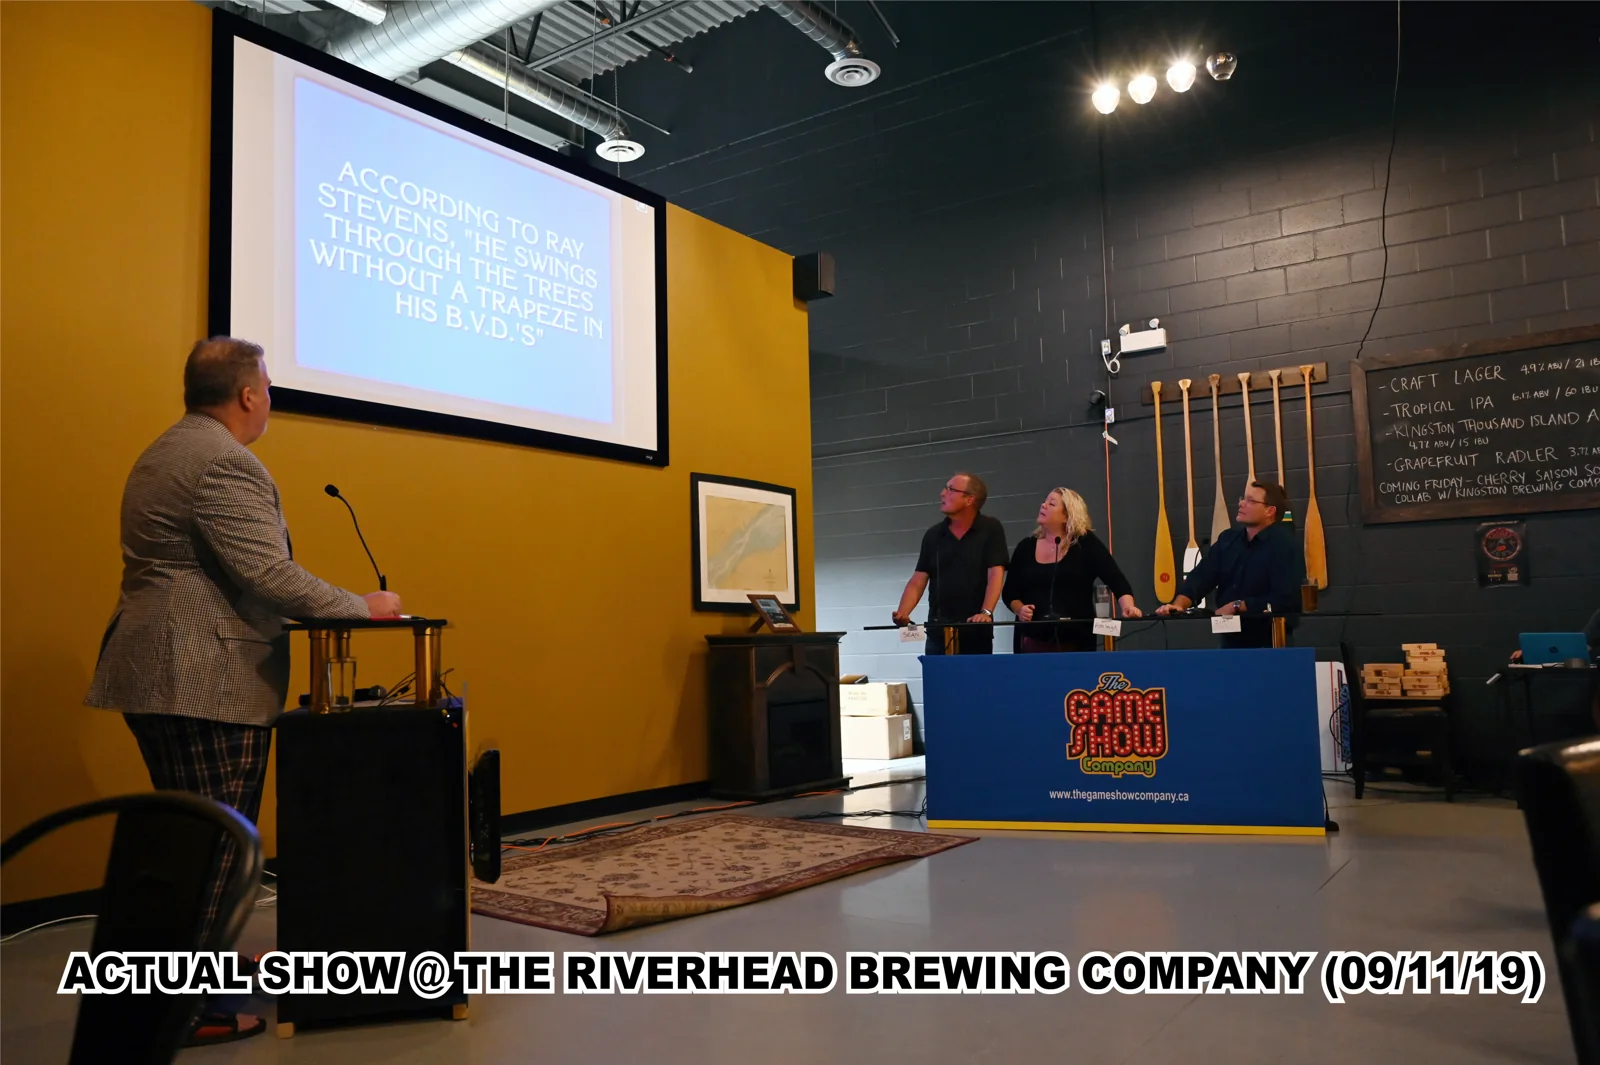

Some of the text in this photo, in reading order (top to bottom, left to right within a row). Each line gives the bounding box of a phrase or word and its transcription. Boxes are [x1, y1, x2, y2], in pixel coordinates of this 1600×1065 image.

[338, 161, 584, 260] ACCORDING TO RAY
[318, 182, 598, 289] STEVENS, "HE SWINGS
[324, 213, 594, 312] THROUGH THE TREES
[309, 238, 604, 340] WITHOUT A TRAPEZE IN
[396, 291, 544, 347] HIS B.V.D.'S"
[1454, 365, 1507, 385] LAGER
[1575, 358, 1585, 369] 21
[1470, 395, 1495, 410] IPA
[1533, 389, 1549, 398] ABV
[1565, 386, 1577, 397] 60
[1581, 385, 1599, 394] IBU
[1457, 416, 1525, 433] THOUSAND
[1530, 411, 1580, 428] ISLAND
[1474, 436, 1489, 446] IBU
[1495, 446, 1559, 464] RADLER
[1379, 480, 1420, 494] COMING
[1477, 469, 1526, 486] CHERRY
[1535, 466, 1578, 482] SAISON
[1395, 492, 1432, 504] COLLAB
[1455, 484, 1507, 498] KINGSTON
[1512, 480, 1564, 495] BREWING
[1101, 675, 1128, 690] The
[1068, 691, 1163, 724] GAME
[1069, 722, 1164, 756] SHOW
[1082, 757, 1153, 775] Company
[1049, 789, 1190, 804] www.thegameshowcompany.ca
